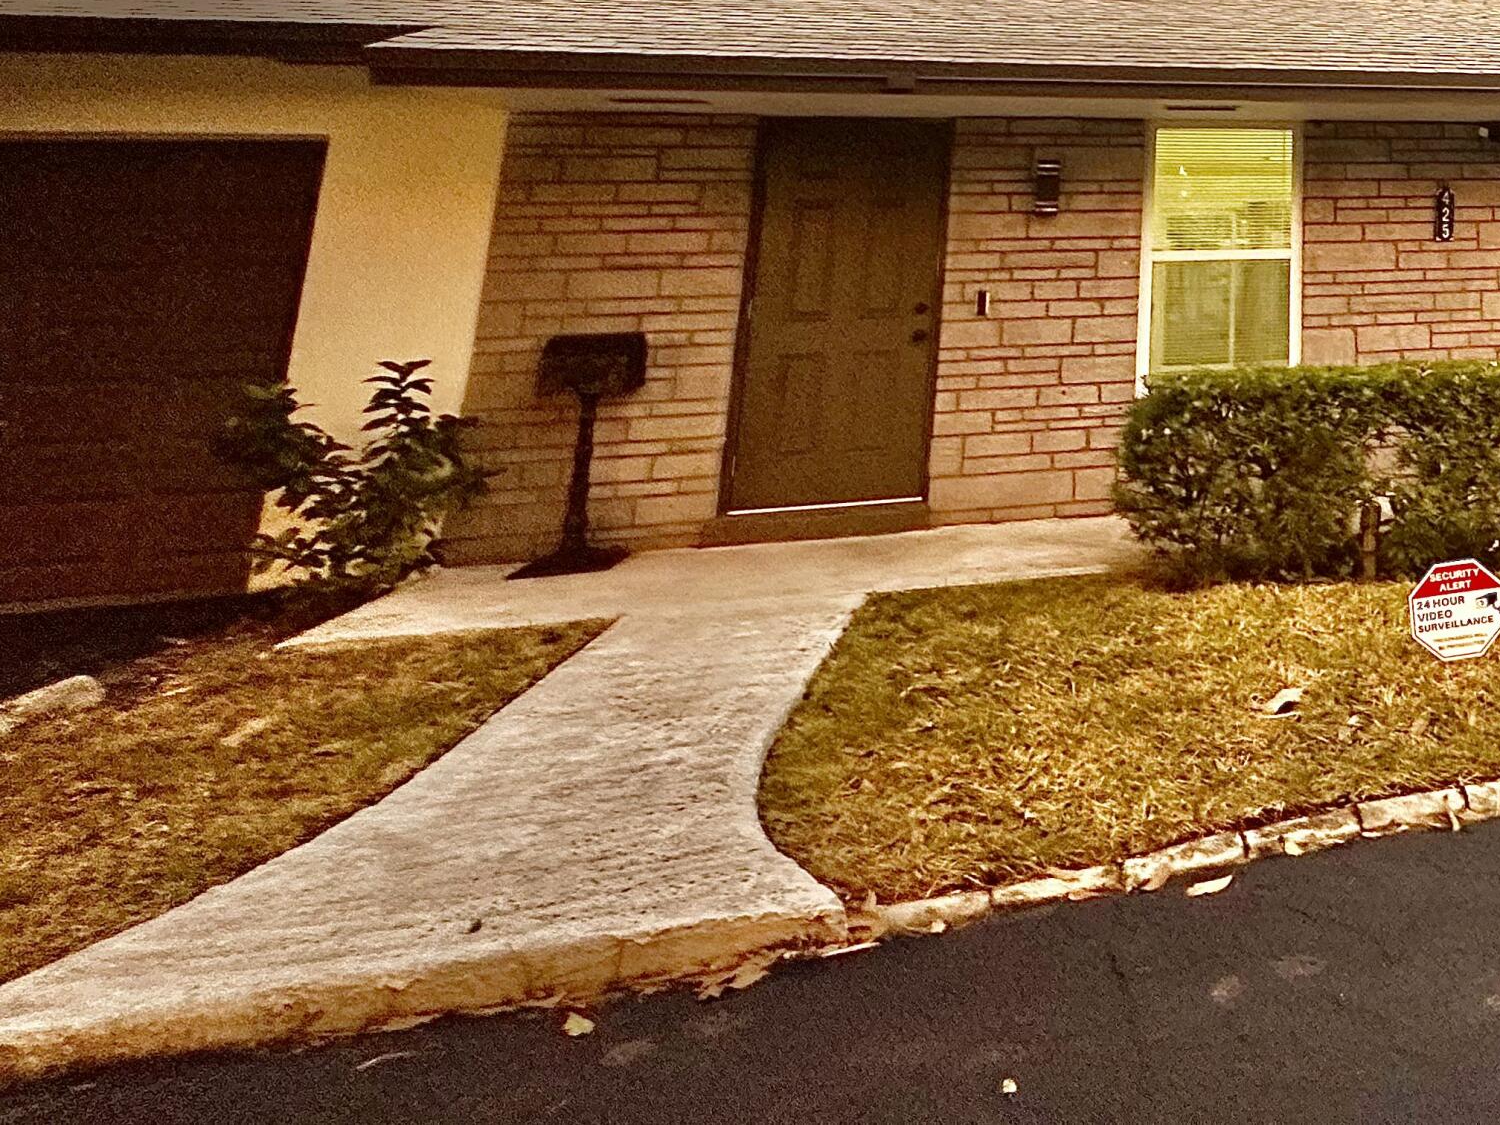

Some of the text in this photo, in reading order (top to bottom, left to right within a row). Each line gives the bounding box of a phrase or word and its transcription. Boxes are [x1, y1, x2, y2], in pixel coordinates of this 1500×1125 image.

[1442, 191, 1450, 238] 425
[1429, 568, 1480, 583] SECURITY
[1439, 580, 1472, 592] ALERT
[1416, 596, 1465, 610] 24 HOUR
[1417, 610, 1453, 622] VIDEO
[1418, 615, 1494, 633] SURVEILLANCE
